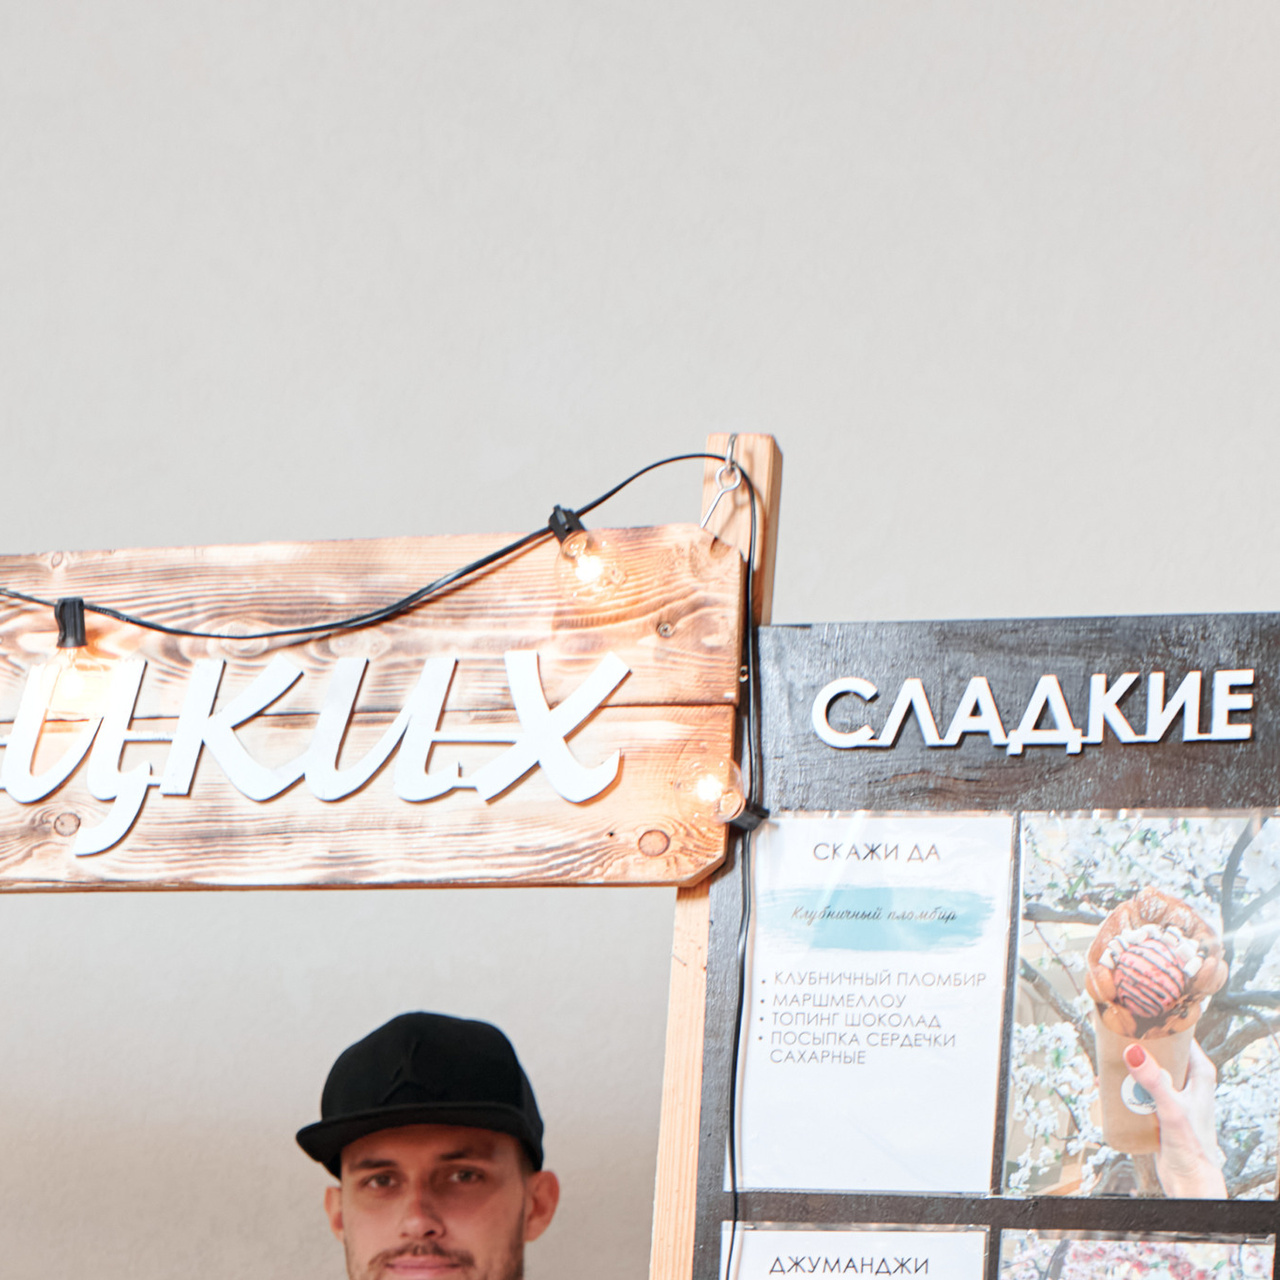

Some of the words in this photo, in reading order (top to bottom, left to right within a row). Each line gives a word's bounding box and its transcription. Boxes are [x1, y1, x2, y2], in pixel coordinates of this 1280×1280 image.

[811, 669, 1255, 755] СЛАДКИЕ
[813, 842, 899, 861] СКАЖИ
[907, 843, 941, 862] ДА
[791, 905, 882, 926] Клубничный
[887, 906, 957, 924] пломбир
[774, 969, 891, 987] КЛУБНИЧНЫЙ
[897, 972, 987, 987] ПЛОМБИР
[773, 994, 907, 1008] МАРШМЕЛЛОУ
[773, 1012, 839, 1027] ТОПИНГ
[845, 1013, 941, 1029] ШОКОЛАД
[771, 1031, 860, 1047] ПОСЫПКА
[866, 1032, 955, 1048] СЕРДЕЧКИ
[770, 1049, 866, 1065] САХАРНЫЕ
[770, 1256, 929, 1275] ДЖУМАНДЖИ
